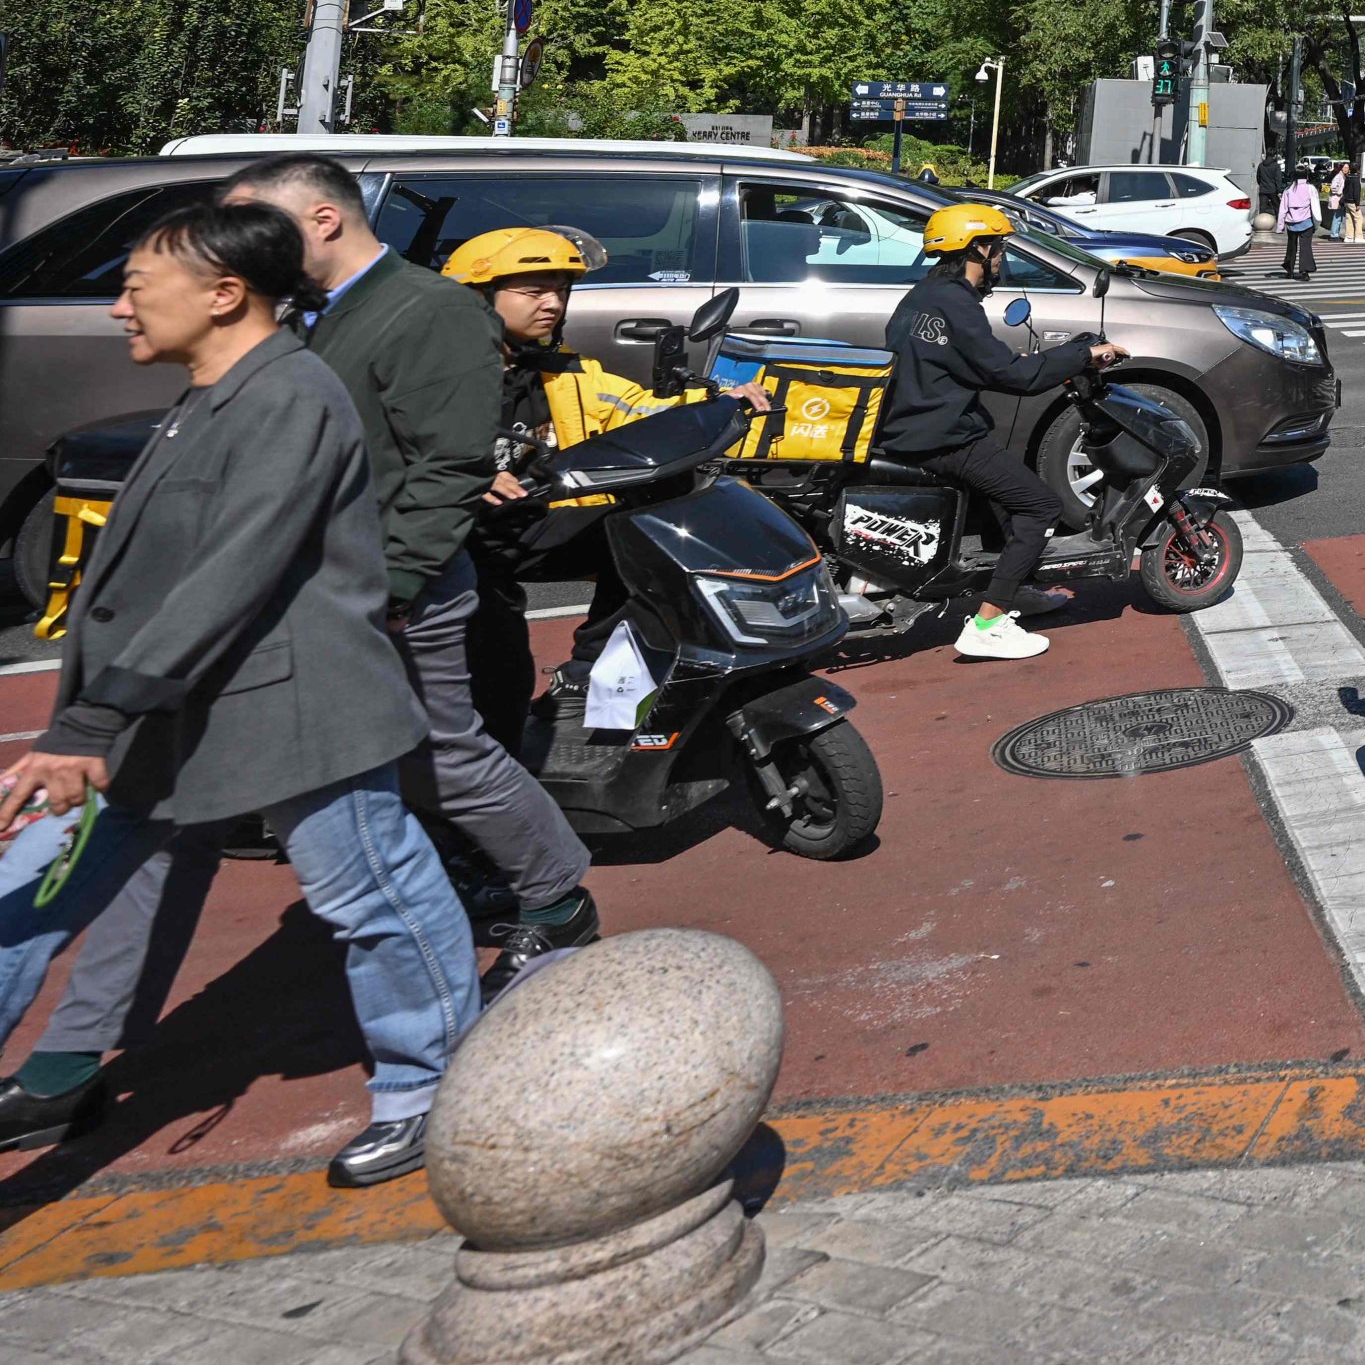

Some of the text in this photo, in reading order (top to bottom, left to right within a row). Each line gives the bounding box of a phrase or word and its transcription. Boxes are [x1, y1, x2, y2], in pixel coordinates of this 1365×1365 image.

[882, 83, 920, 92] 光华路
[1155, 79, 1171, 94] 37
[692, 130, 751, 141] KERRY CENTRE
[790, 422, 828, 439] 闪送
[850, 514, 937, 559] POWER
